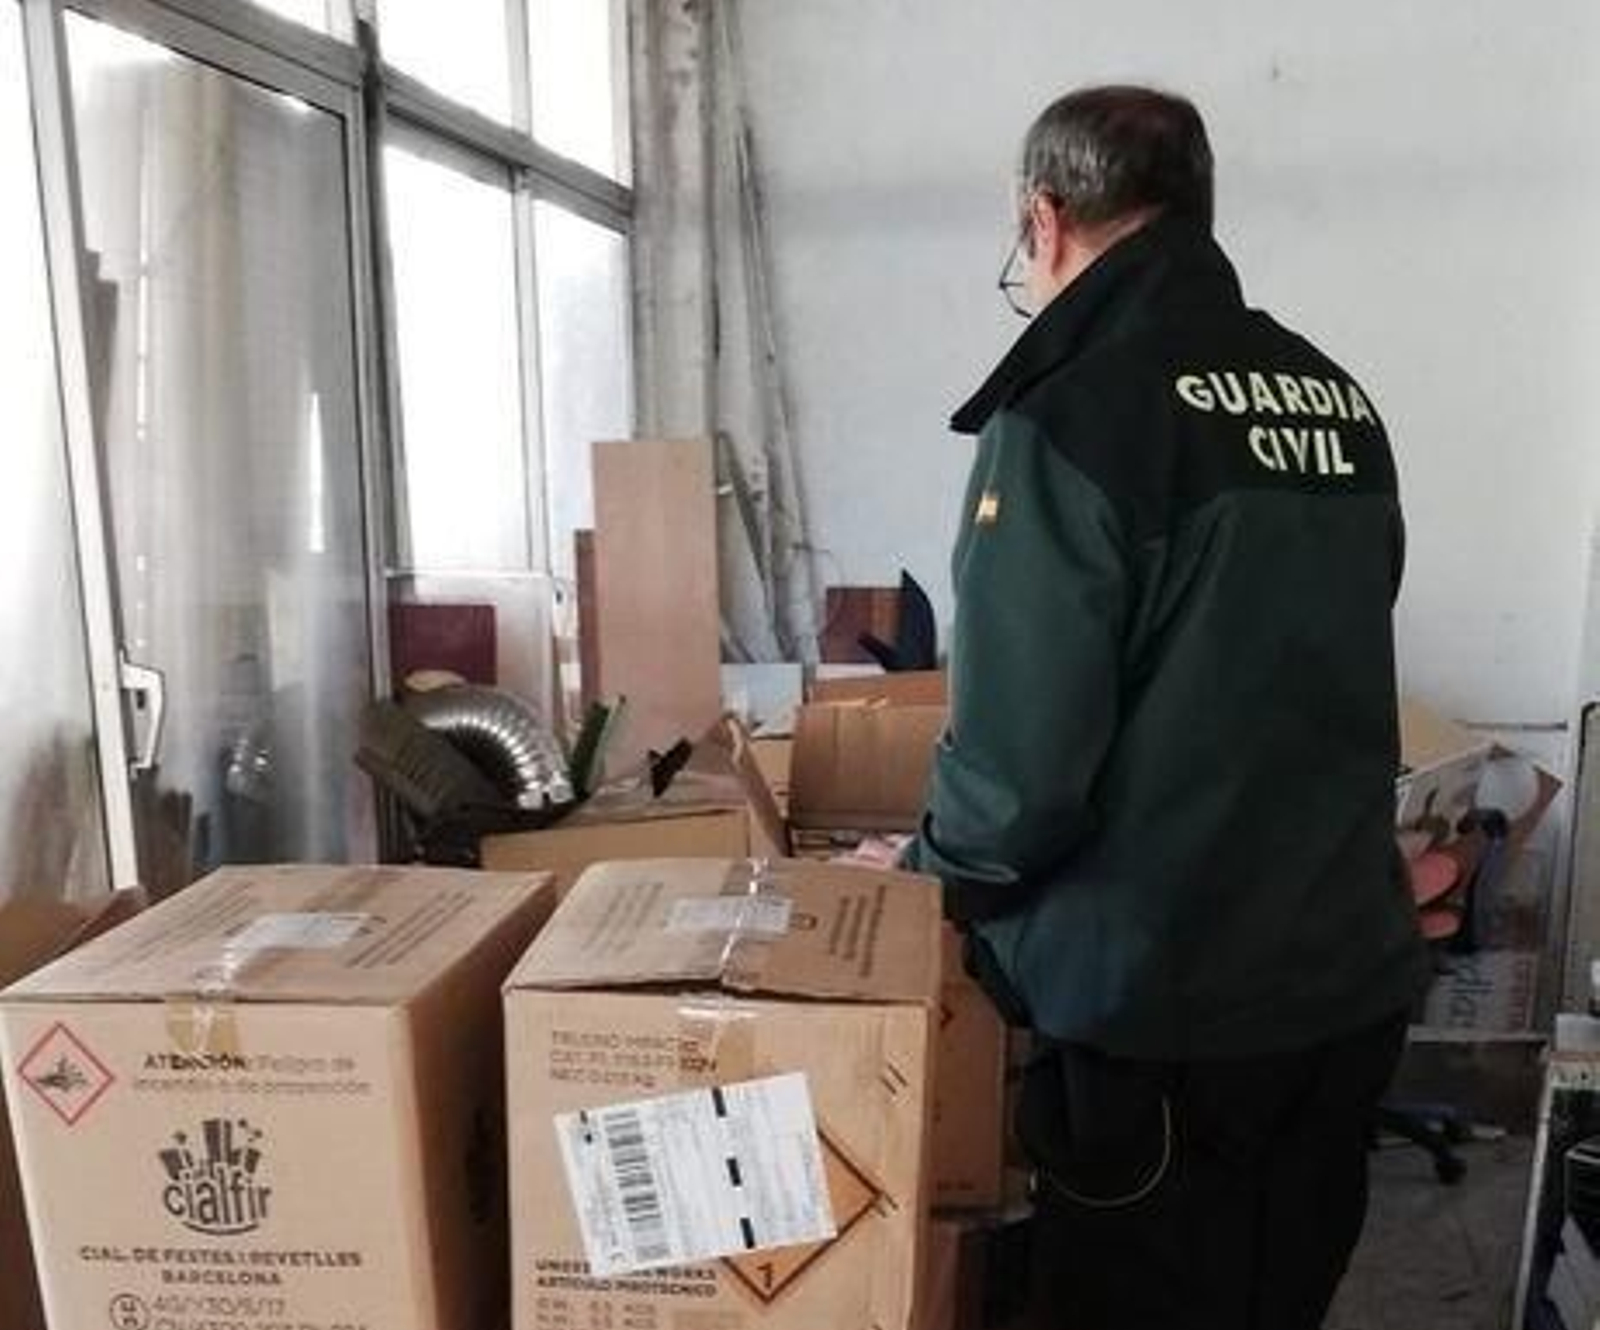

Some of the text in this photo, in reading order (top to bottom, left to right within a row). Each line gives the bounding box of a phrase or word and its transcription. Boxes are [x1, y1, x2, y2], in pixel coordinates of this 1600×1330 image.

[1175, 371, 1376, 426] GUARDIA
[1248, 425, 1355, 475] CIVIL
[163, 1167, 272, 1225] cialfir
[132, 1247, 159, 1264] DE
[164, 1248, 236, 1265] FESTES
[249, 1250, 363, 1267] REVETLLES
[756, 1262, 774, 1290] 1
[161, 1270, 282, 1286] BARCELONA
